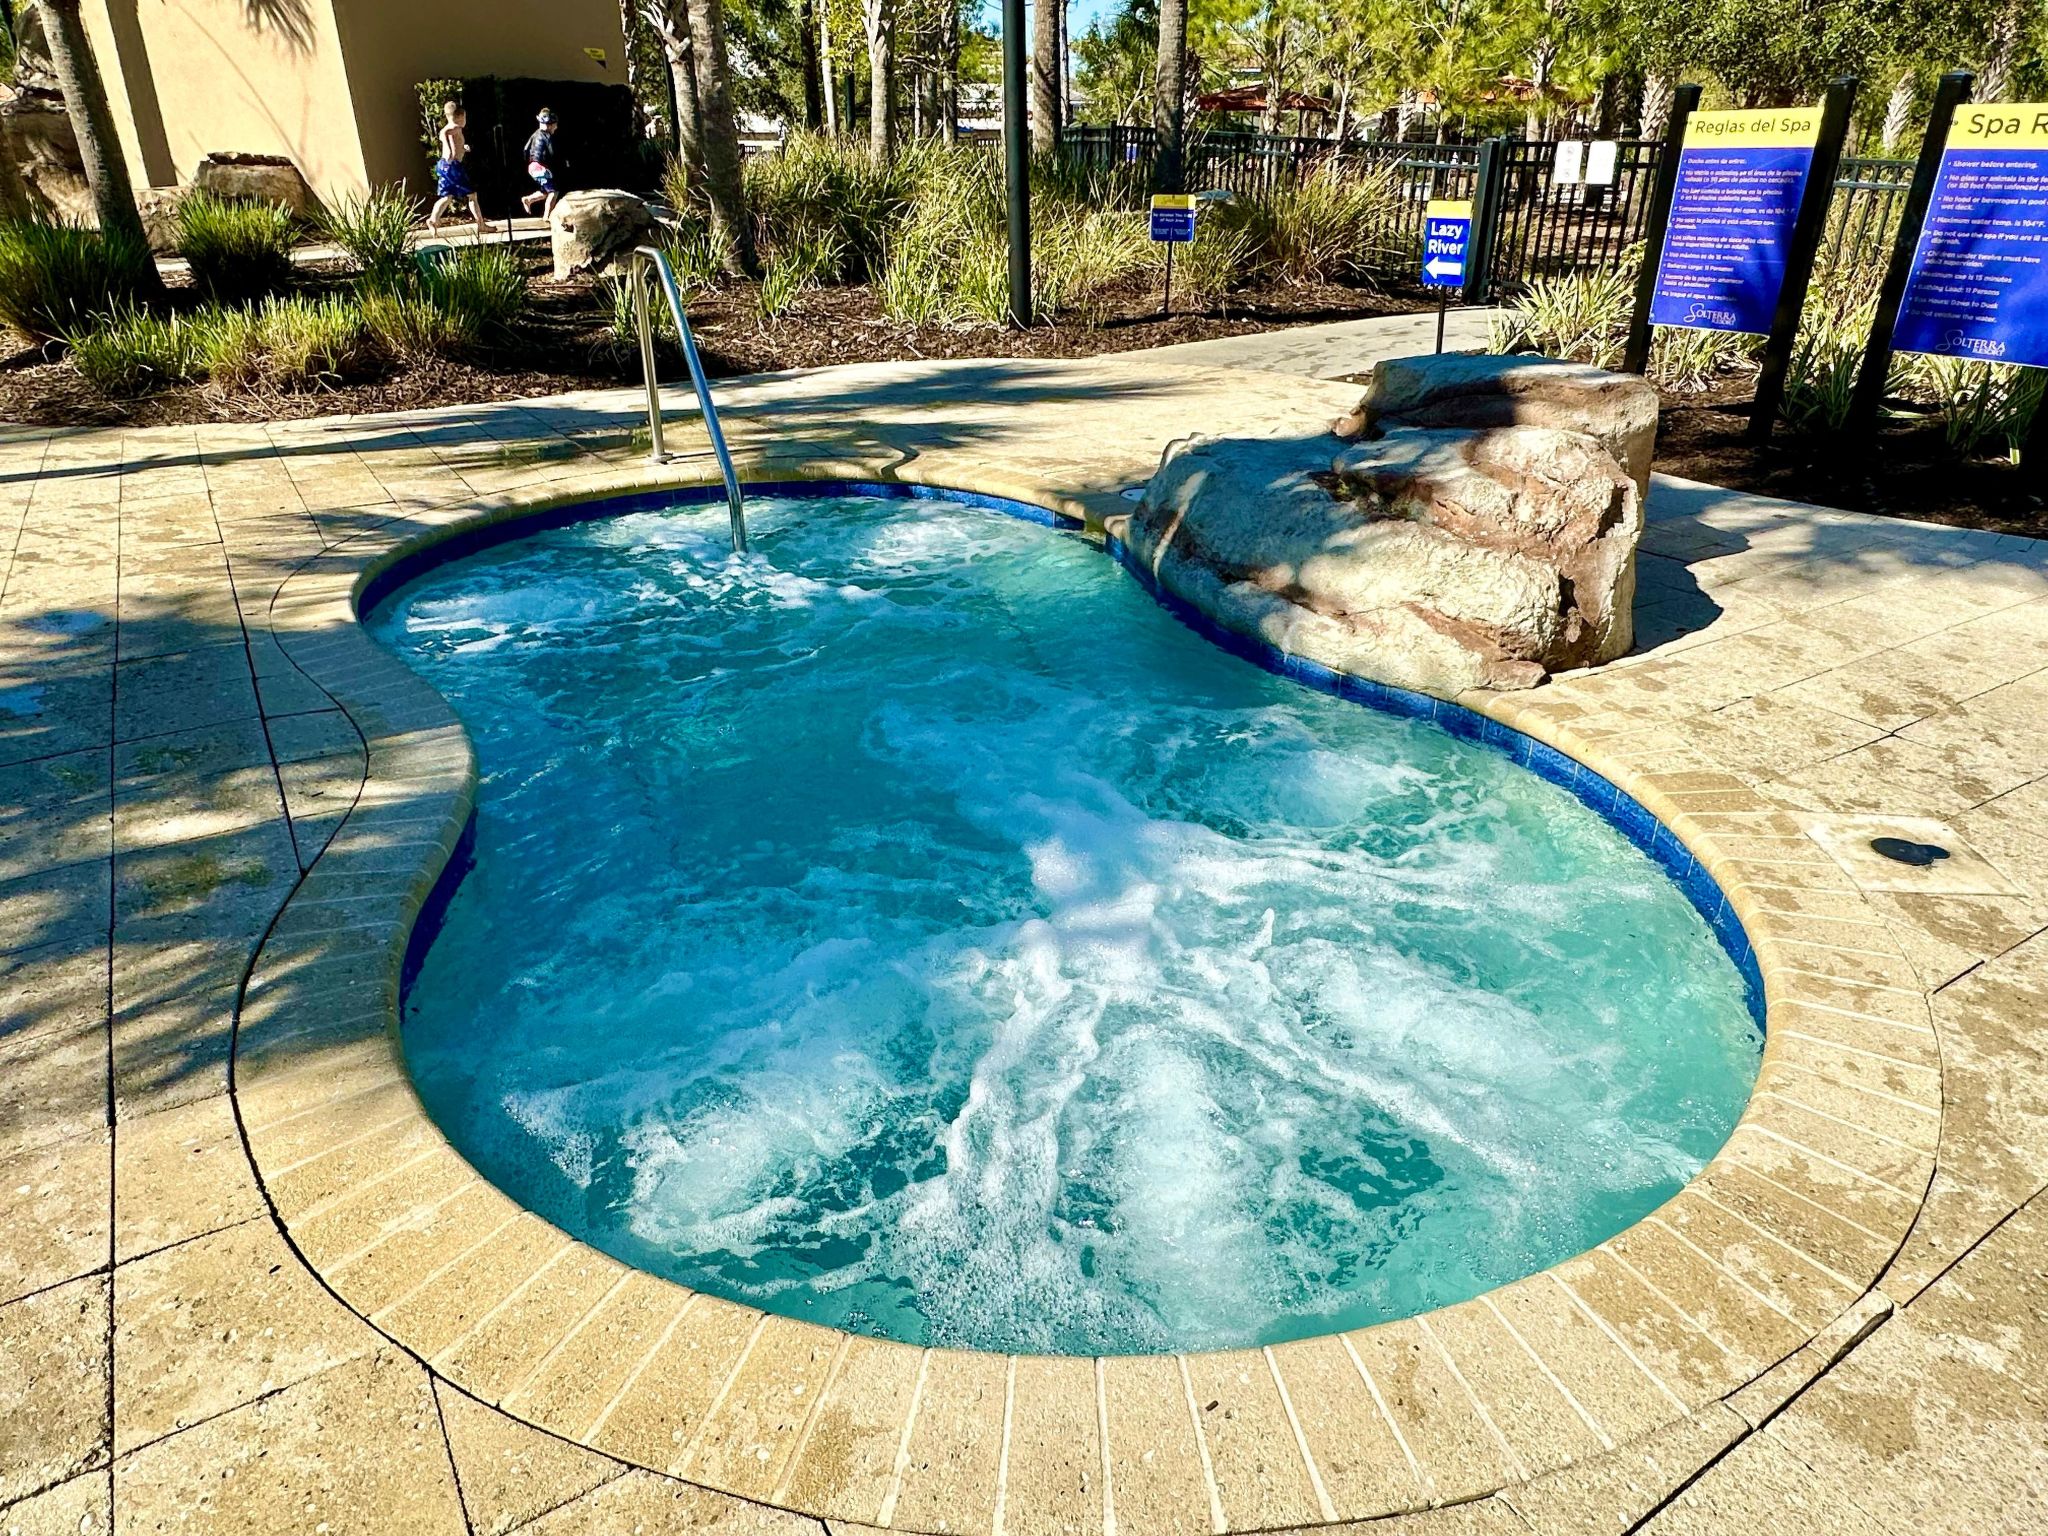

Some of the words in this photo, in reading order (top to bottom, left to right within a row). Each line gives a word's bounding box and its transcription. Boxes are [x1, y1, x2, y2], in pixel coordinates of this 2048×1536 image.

[1695, 120, 1745, 135] Reglas
[1751, 119, 1775, 133] del
[1780, 118, 1811, 135] Spa
[1968, 114, 2021, 138] Spa
[2006, 161, 2039, 169] entering.
[2027, 175, 2039, 183] the
[1981, 197, 2018, 205] beverages
[2028, 198, 2044, 206] pool
[1431, 221, 1463, 240] Lazy
[2005, 233, 2019, 241] you
[1428, 239, 1464, 255] River
[2022, 255, 2040, 263] have
[1984, 275, 2012, 284] minutes
[1972, 287, 2000, 296] Persons
[1971, 300, 1980, 308] to
[1980, 301, 1999, 309] Dusk
[1684, 303, 1736, 323] SOLTERRA
[1975, 315, 1997, 323] water.
[1935, 329, 2006, 351] SOLTERRA
